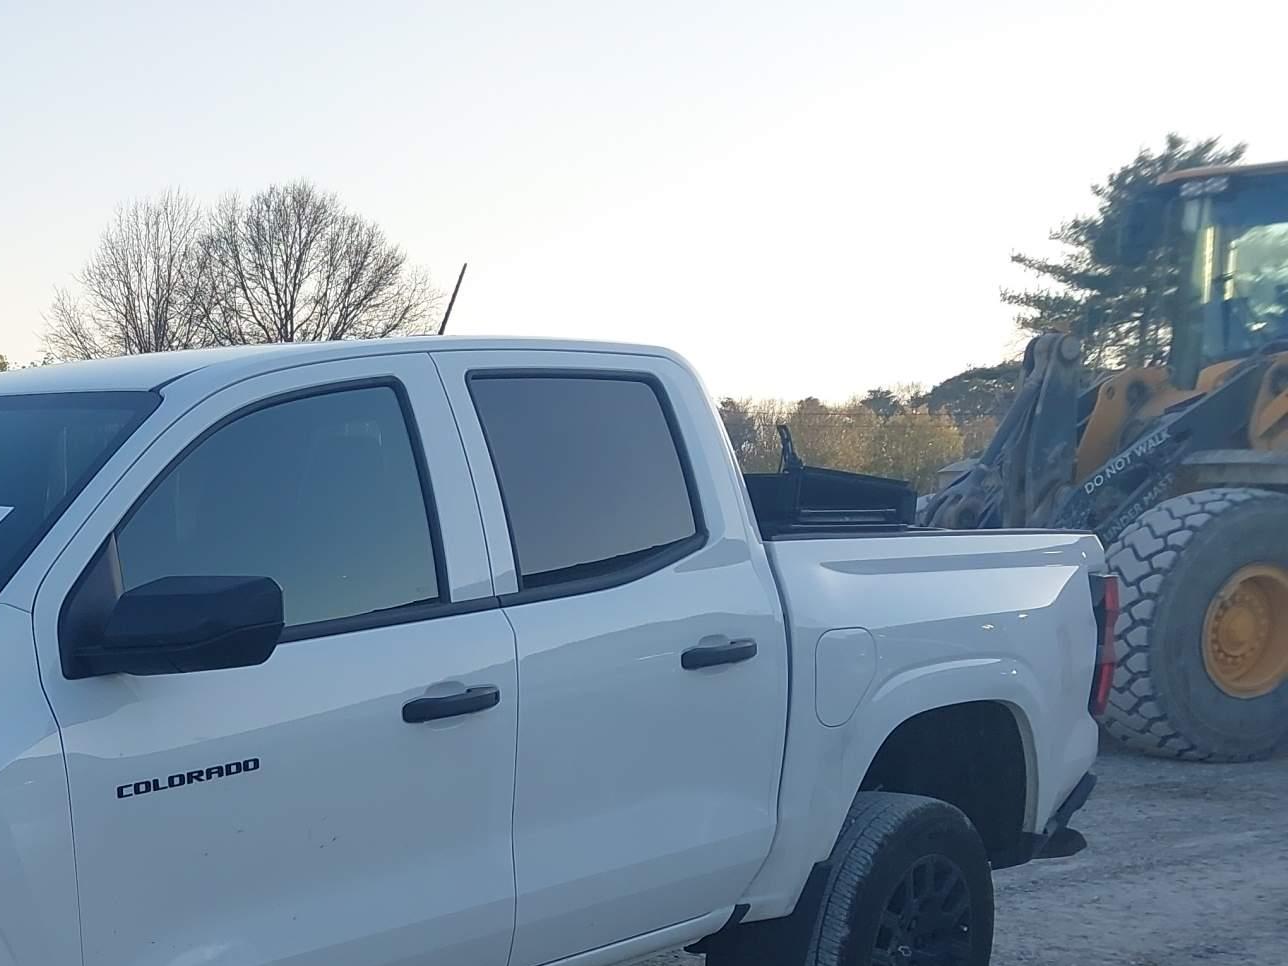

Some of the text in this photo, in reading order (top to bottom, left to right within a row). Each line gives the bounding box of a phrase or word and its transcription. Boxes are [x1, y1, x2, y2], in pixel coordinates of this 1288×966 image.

[1084, 430, 1171, 494] DO NOT WALK
[1102, 503, 1144, 541] UNDER
[116, 758, 261, 799] COLORADO
